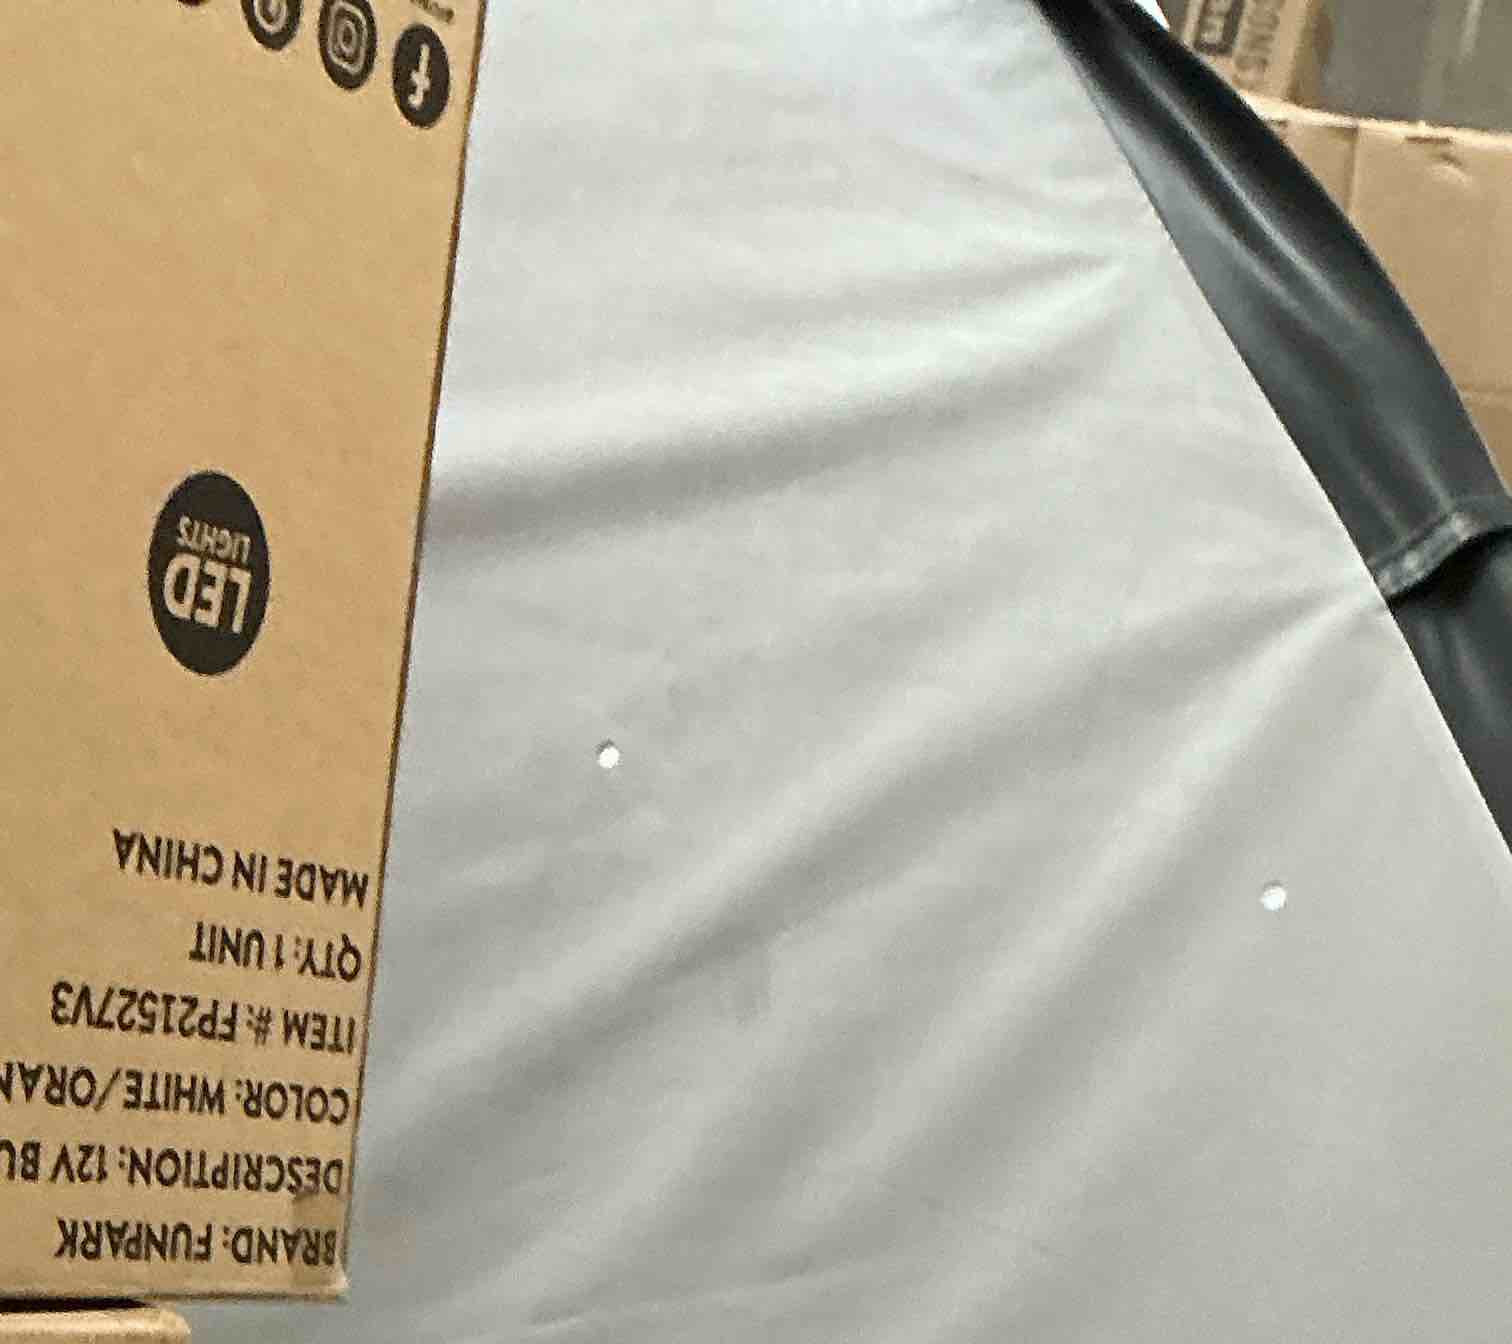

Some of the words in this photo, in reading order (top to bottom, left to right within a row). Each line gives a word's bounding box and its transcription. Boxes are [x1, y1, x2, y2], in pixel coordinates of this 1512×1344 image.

[177, 515, 251, 566] LIGHTS
[163, 553, 252, 634] LED
[112, 828, 224, 886] CHINA
[232, 851, 268, 893] IN
[276, 858, 369, 910] MADE
[189, 920, 266, 970] UNIT
[273, 933, 284, 971] 1
[298, 933, 363, 983] QTY:
[51, 980, 239, 1043] FP21527V3
[282, 1008, 357, 1054] ITEM
[235, 1078, 351, 1126] COLOR:
[50, 1143, 109, 1184] 12V
[119, 1146, 345, 1196] DESCRIPTION:
[53, 1217, 214, 1263] FUNPARK
[222, 1225, 339, 1266] BRAND:
